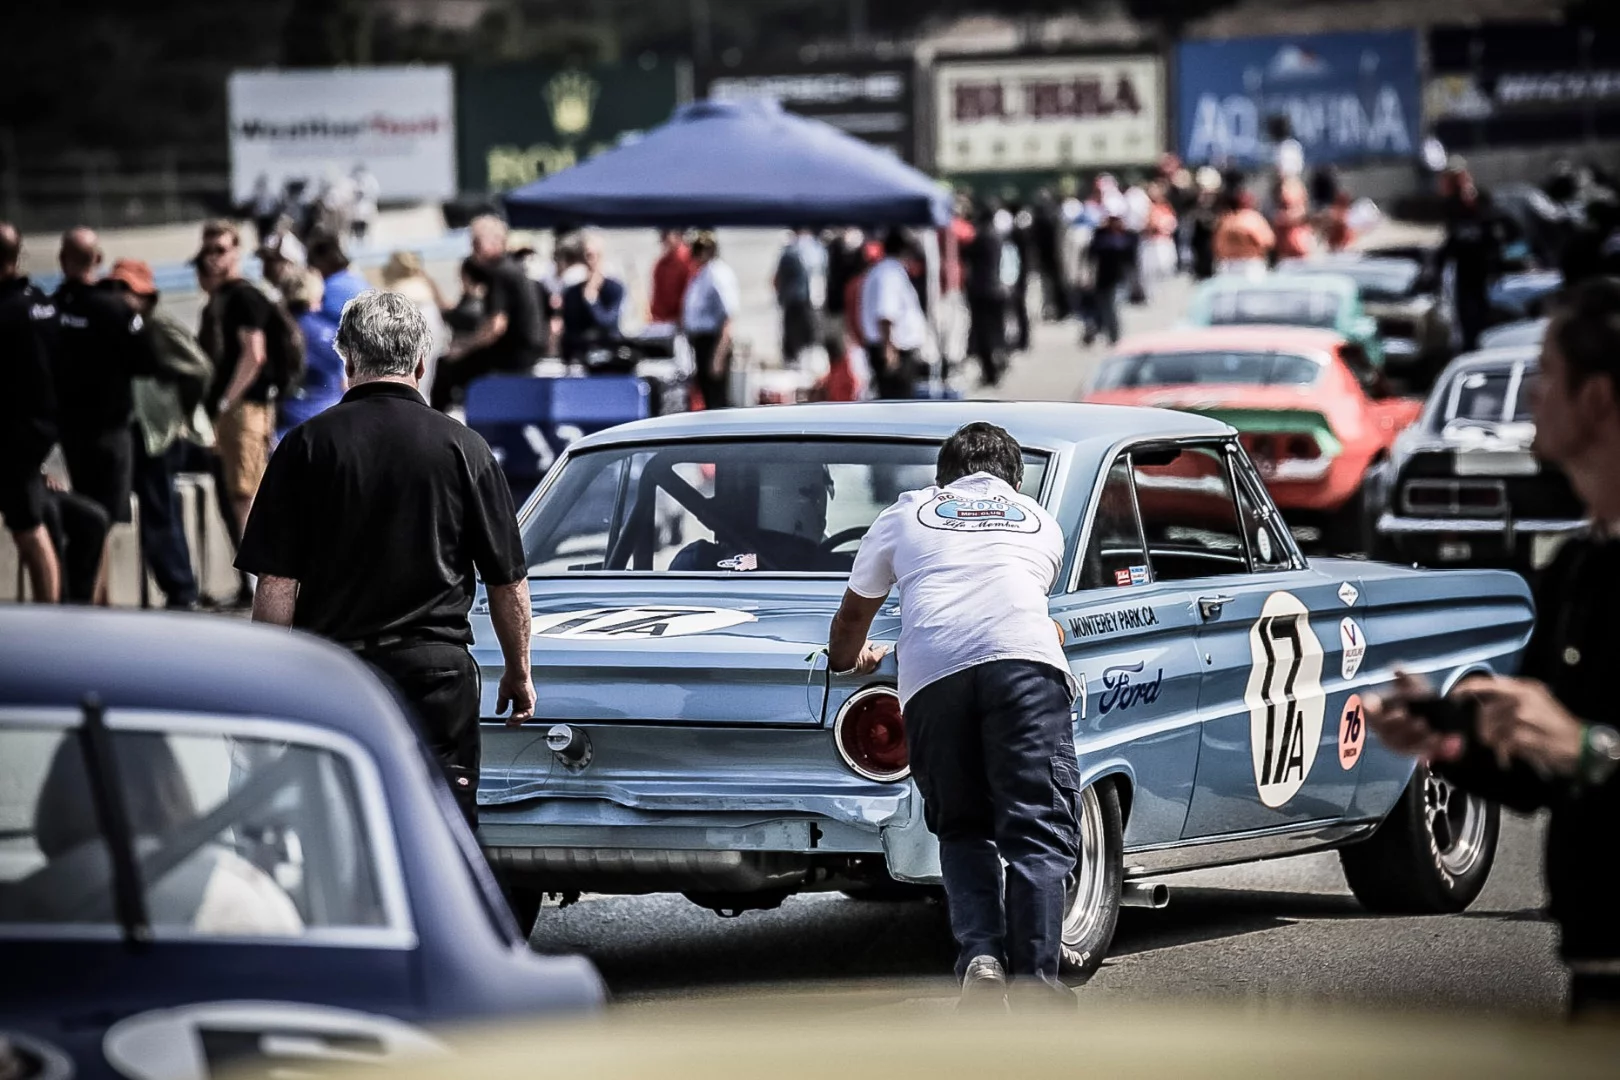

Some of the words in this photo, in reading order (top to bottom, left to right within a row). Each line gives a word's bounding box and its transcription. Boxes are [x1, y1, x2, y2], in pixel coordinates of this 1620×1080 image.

[1068, 611, 1118, 639] MONTEREY
[1098, 660, 1163, 715] Ford
[1255, 613, 1304, 787] 17A
[1343, 704, 1361, 745] 76
